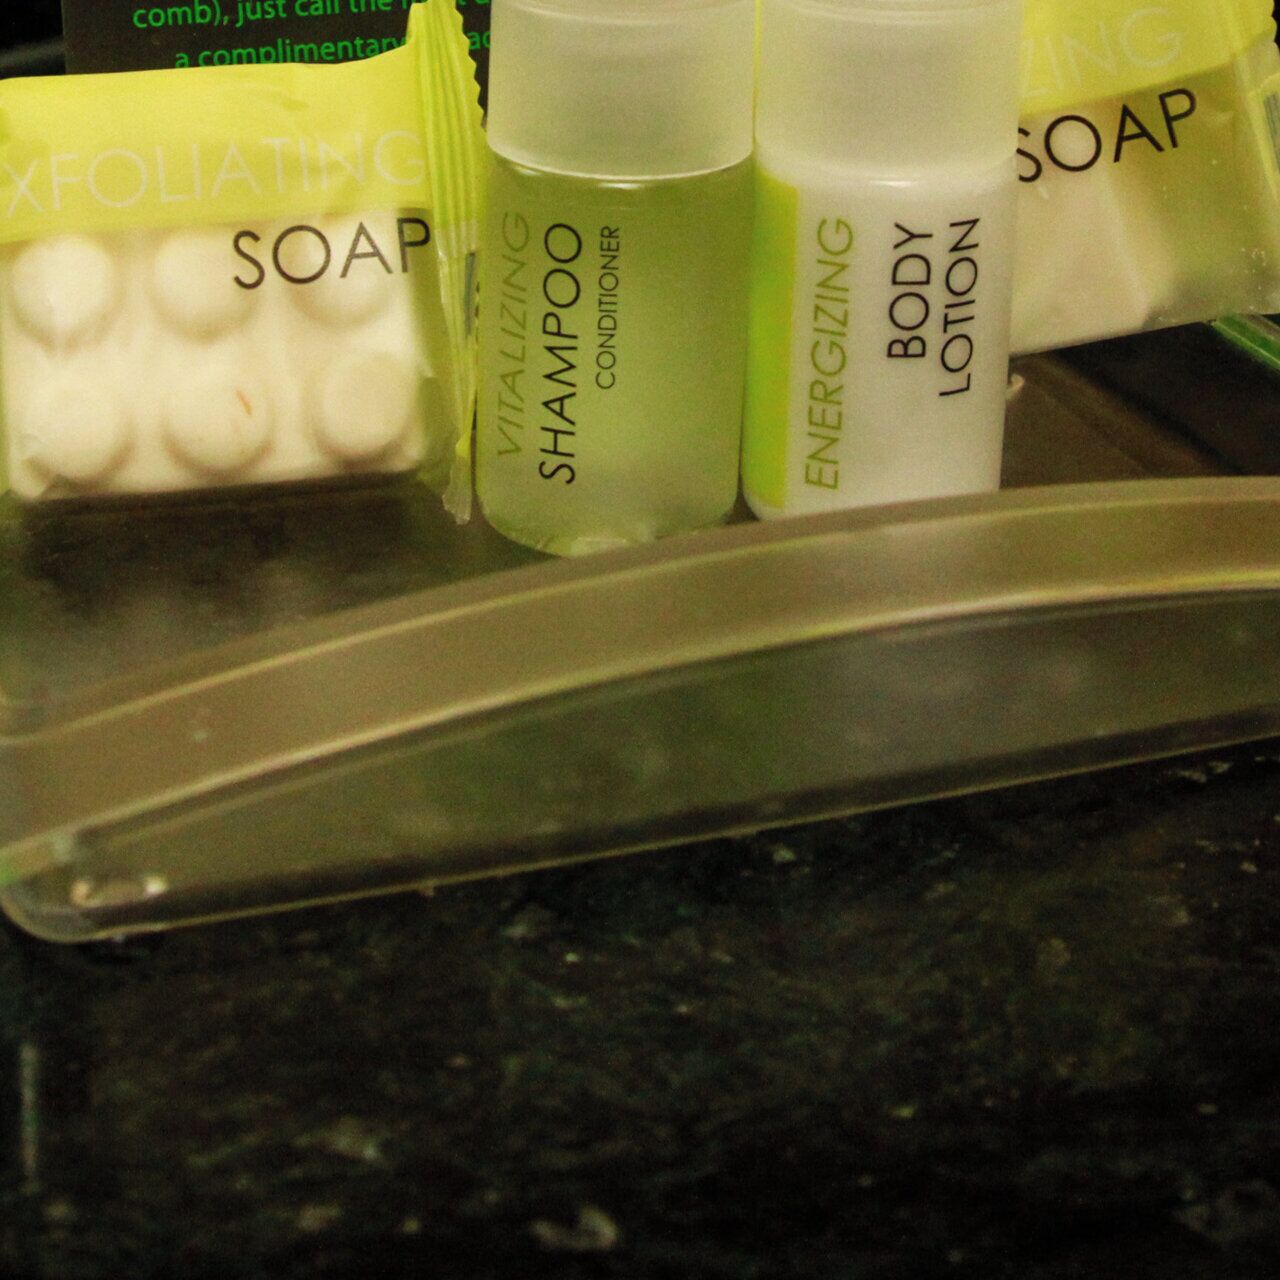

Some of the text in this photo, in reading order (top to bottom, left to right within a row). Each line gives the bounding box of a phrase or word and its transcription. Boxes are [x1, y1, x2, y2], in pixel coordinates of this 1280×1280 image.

[175, 52, 190, 69] a
[1016, 88, 1197, 184] SOAP
[233, 216, 432, 290] SOAP
[497, 211, 531, 459] VITALIZING
[595, 224, 621, 390] CONDITIONER
[887, 221, 934, 359] BODY
[939, 216, 981, 398] LOTION
[538, 222, 583, 485] SHAMPOO
[805, 216, 854, 491] ENERGIZING
